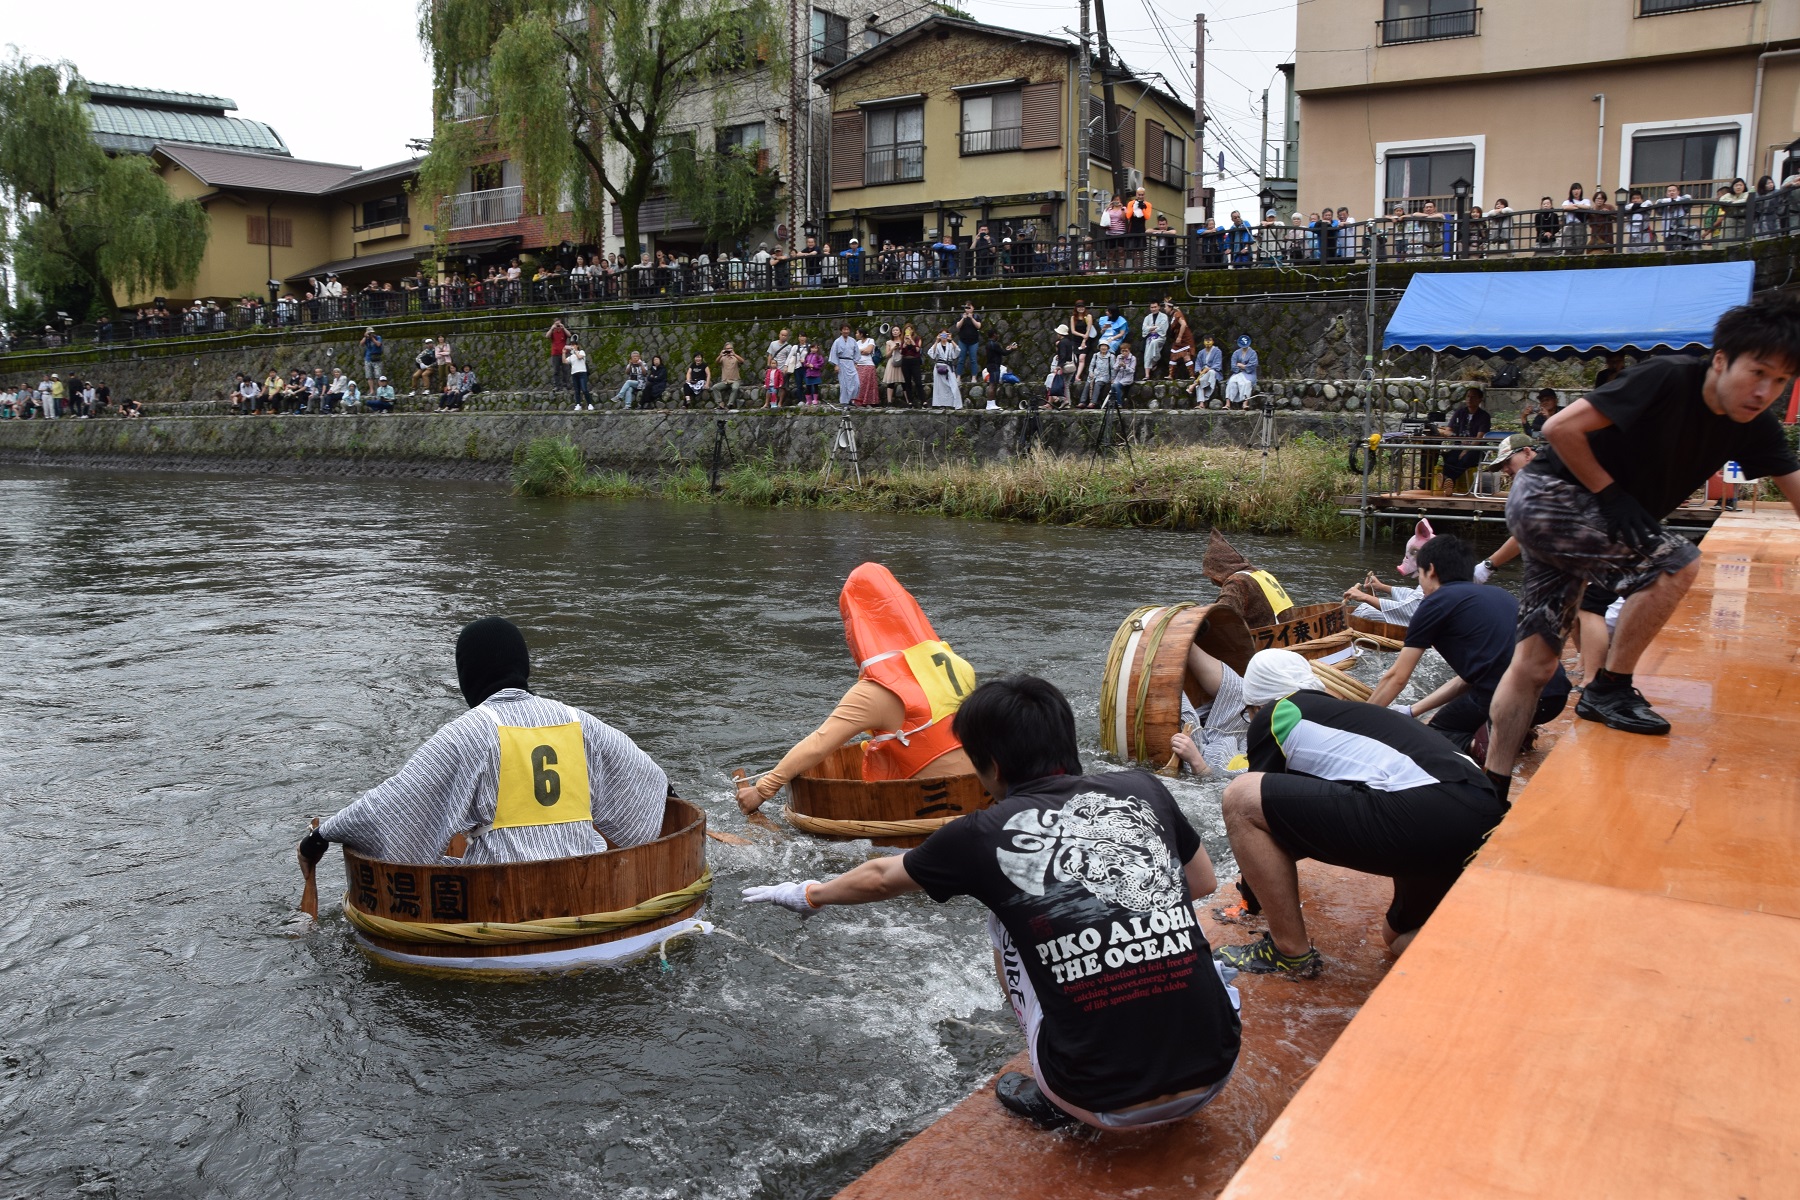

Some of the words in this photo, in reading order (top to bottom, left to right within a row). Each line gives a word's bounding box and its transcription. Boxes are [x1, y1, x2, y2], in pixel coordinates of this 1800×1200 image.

[931, 652, 963, 697] 7
[531, 744, 561, 807] 6
[1035, 927, 1102, 965] PIKO
[1108, 905, 1195, 946] ALOHA
[1051, 952, 1103, 984] THE
[1104, 930, 1193, 968] OCEAN
[1097, 968, 1137, 984] vibration
[1139, 965, 1146, 974] is
[1166, 958, 1183, 968] free
[1073, 986, 1109, 1003] catching
[1083, 1001, 1092, 1012] of
[1093, 998, 1108, 1010] life
[1110, 987, 1150, 1005] spreading
